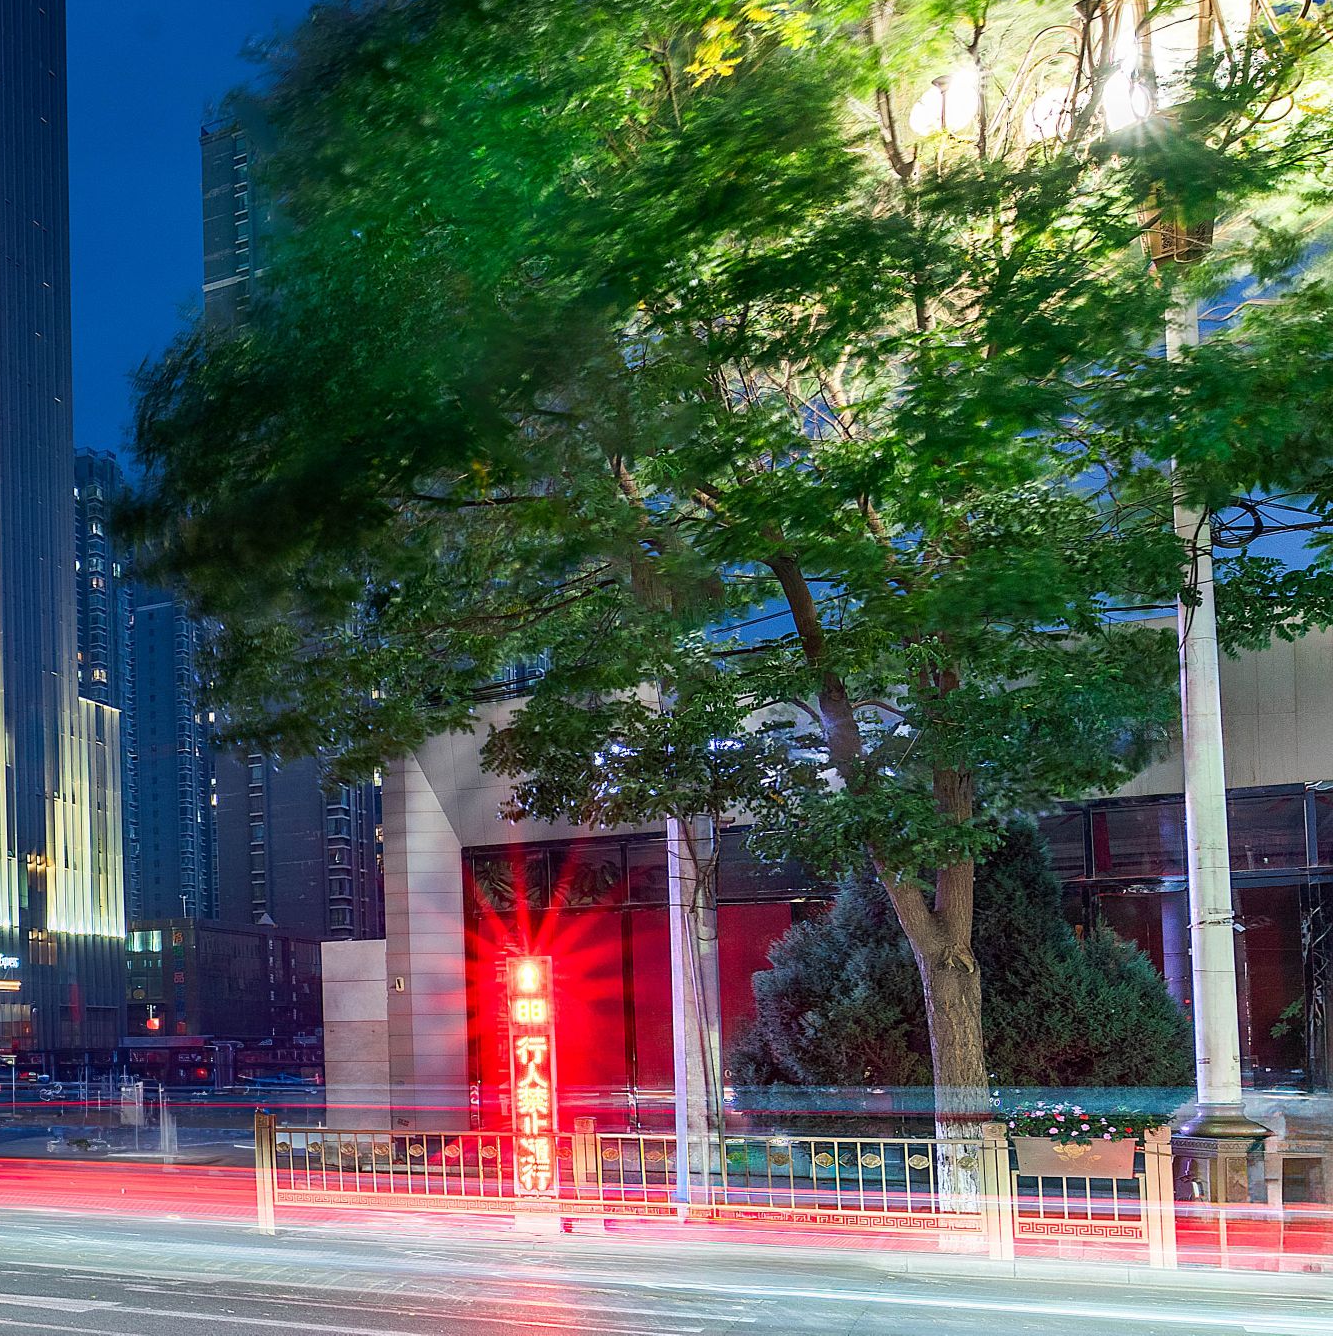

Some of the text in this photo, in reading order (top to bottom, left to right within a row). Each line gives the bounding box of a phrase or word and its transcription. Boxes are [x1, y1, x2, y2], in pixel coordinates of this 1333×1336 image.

[515, 1035, 551, 1191] 行人禁止通行
